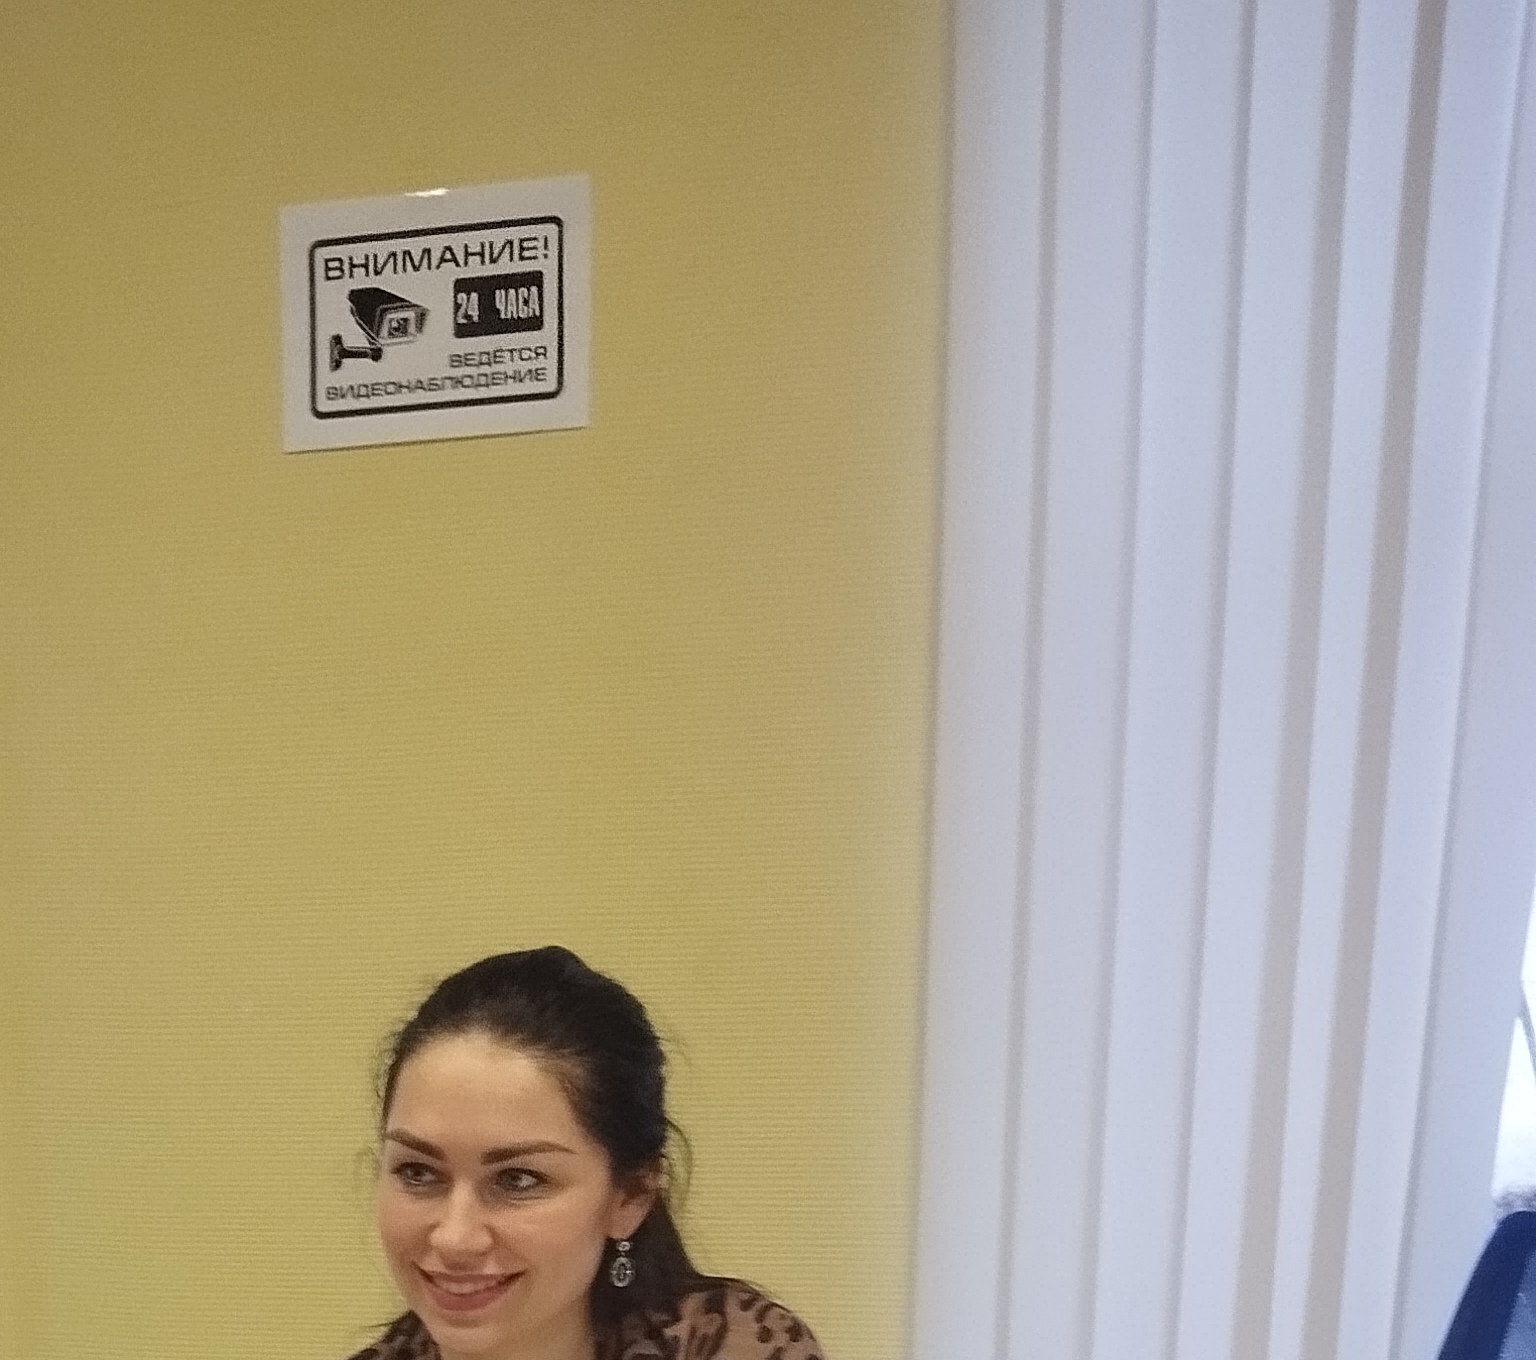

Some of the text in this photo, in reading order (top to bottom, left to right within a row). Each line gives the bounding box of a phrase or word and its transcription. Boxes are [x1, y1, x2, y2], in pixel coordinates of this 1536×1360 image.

[323, 235, 550, 281] ВНИМАНИЕ!
[455, 286, 540, 325] 24 ЧАСА
[326, 366, 547, 401] ВИДЕОНАБЛЮДЕНИЕ
